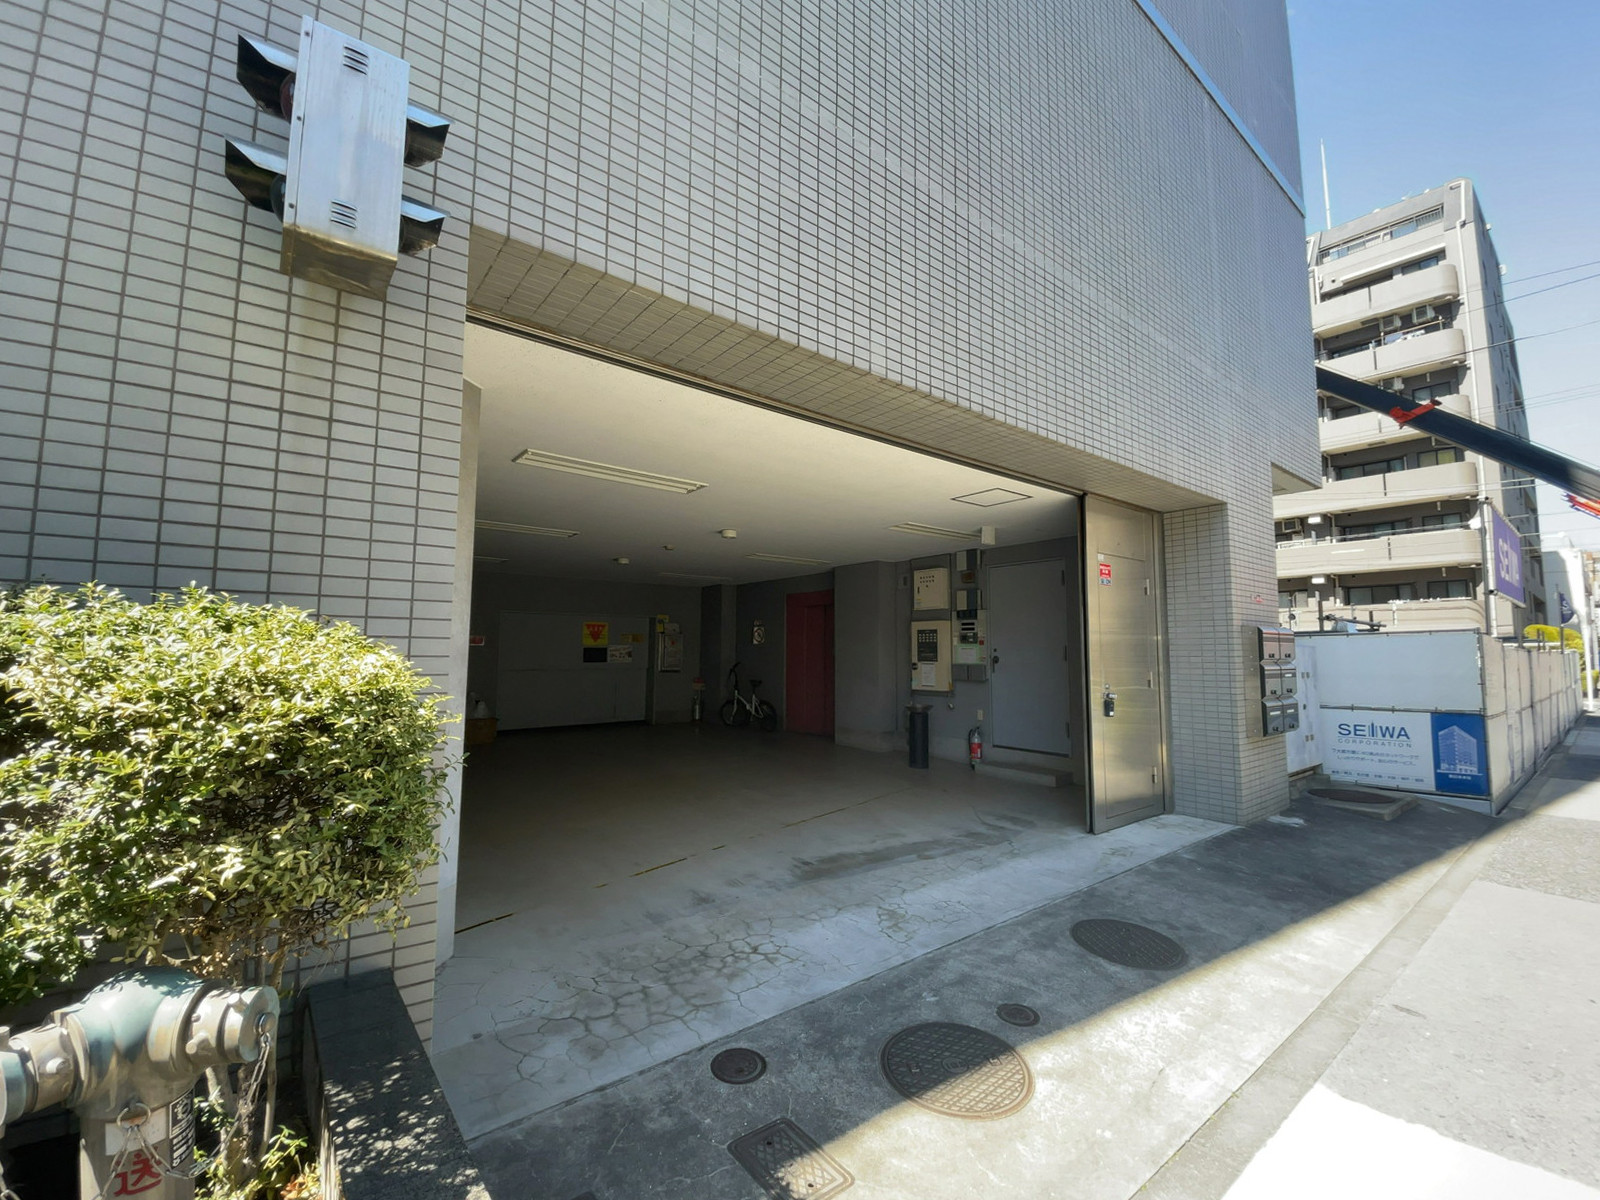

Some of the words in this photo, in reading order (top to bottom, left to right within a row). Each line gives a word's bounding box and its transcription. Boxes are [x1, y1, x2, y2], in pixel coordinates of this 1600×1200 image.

[1338, 720, 1410, 740] SEIWA
[1338, 739, 1412, 748] CORPORATION
[113, 1146, 163, 1197] 送
